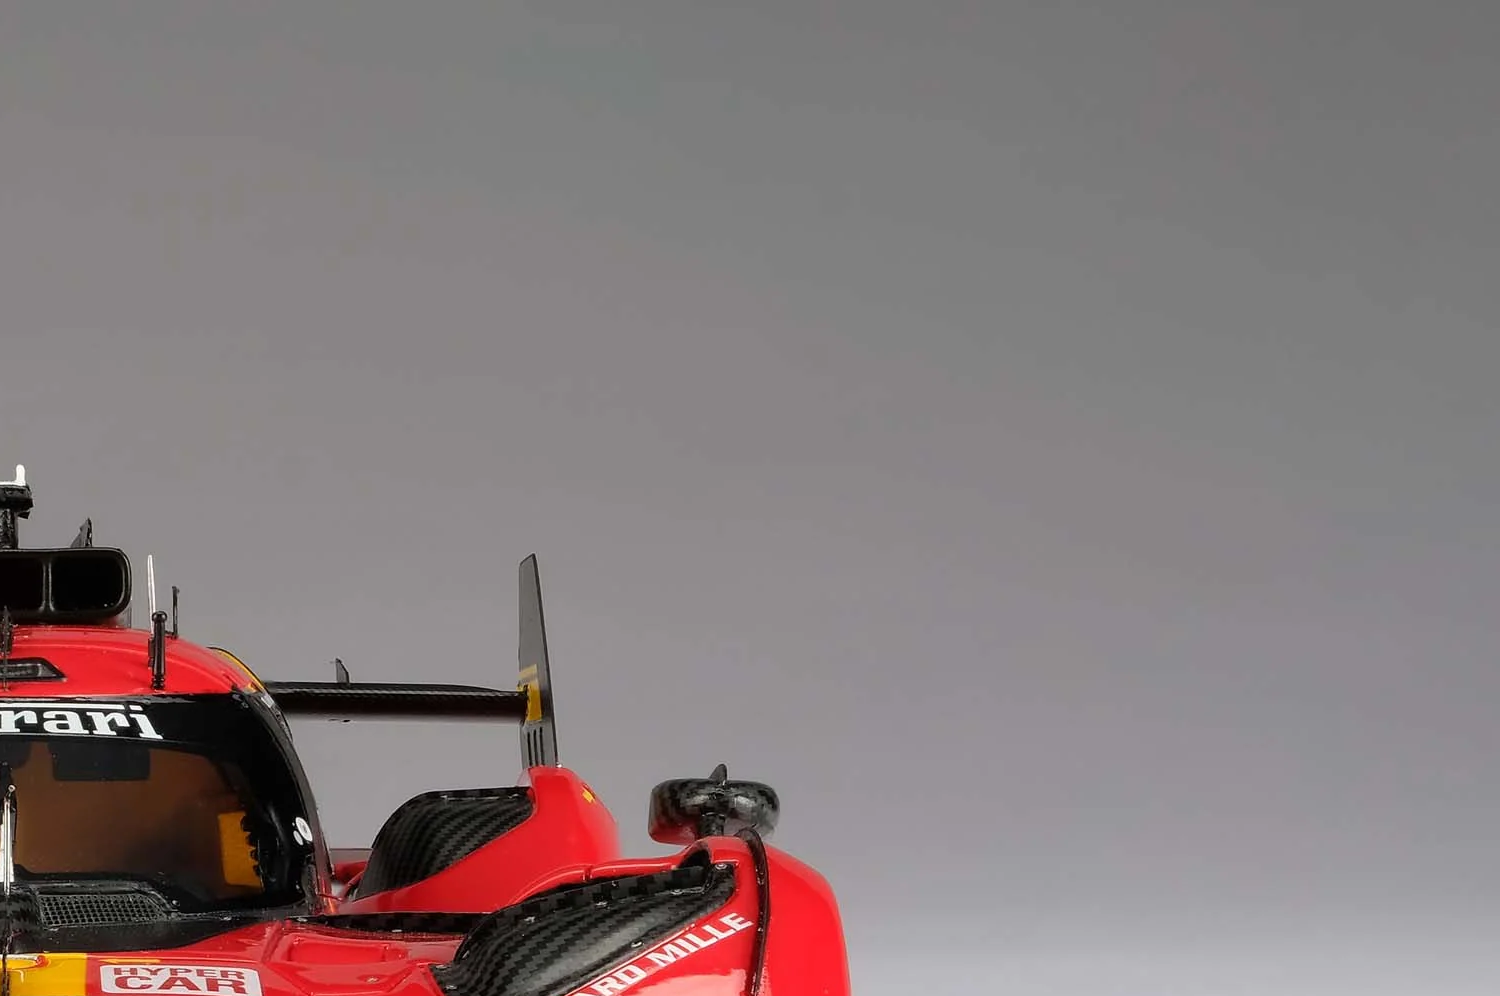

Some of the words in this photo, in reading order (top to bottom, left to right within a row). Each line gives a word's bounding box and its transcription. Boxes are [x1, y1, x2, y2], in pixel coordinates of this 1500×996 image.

[646, 912, 754, 968] MILLE
[113, 967, 245, 980] HYPER
[114, 975, 249, 995] CAR
